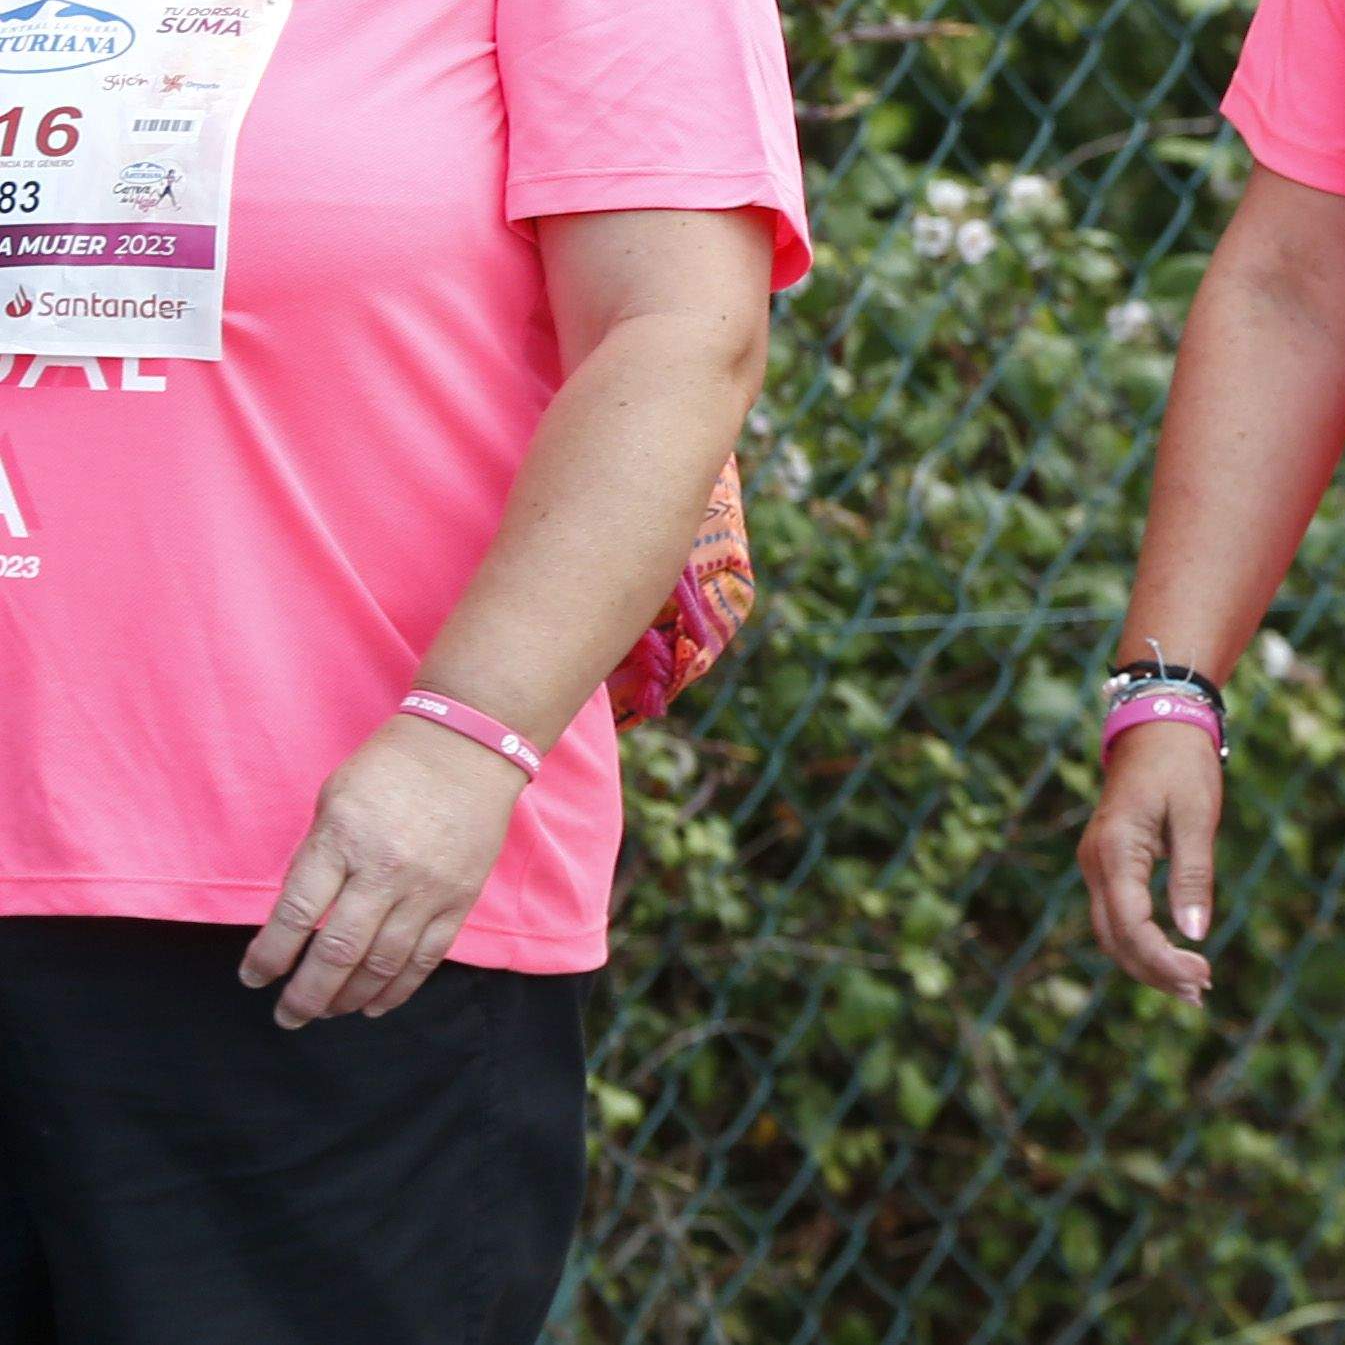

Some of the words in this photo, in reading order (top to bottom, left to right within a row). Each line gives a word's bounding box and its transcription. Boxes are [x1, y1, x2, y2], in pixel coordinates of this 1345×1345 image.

[187, 7, 251, 19] DORSAL
[156, 18, 243, 37] SUMA
[0, 34, 115, 53] TURIANA
[0, 106, 83, 157] 16
[0, 236, 12, 256] A
[17, 235, 107, 255] MUJER
[114, 235, 176, 256] 2023
[37, 292, 188, 319] Santander
